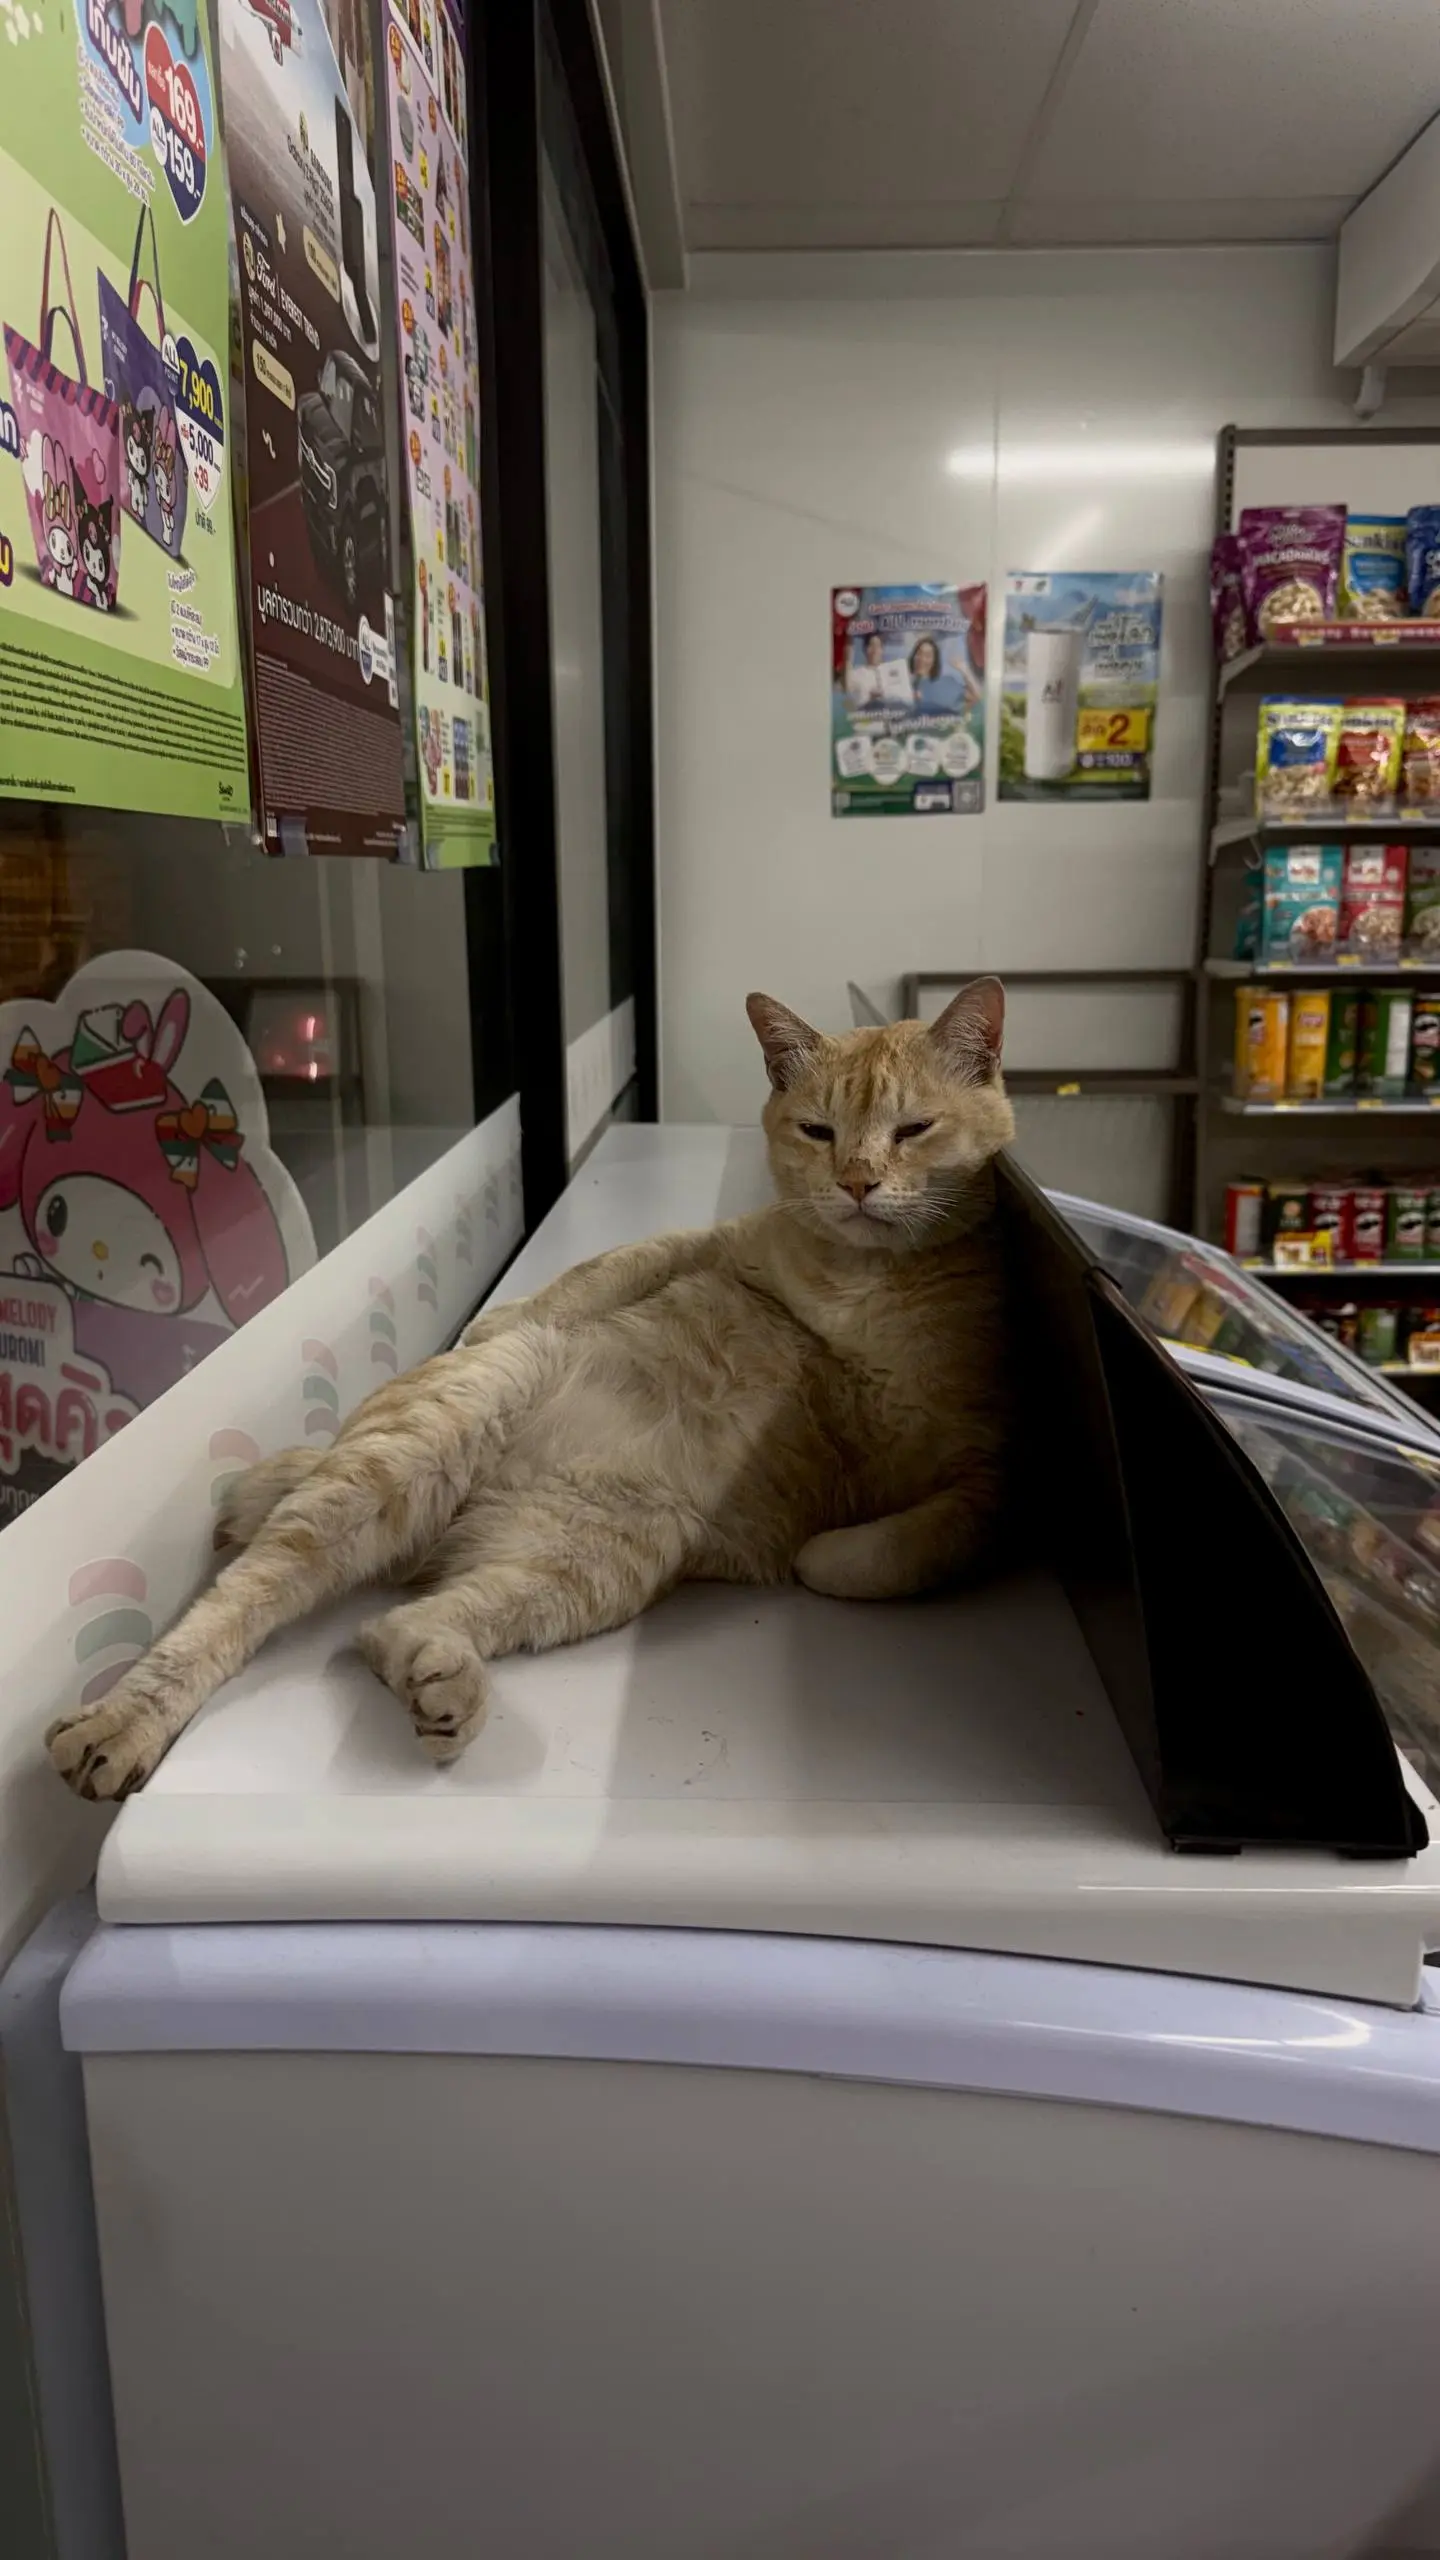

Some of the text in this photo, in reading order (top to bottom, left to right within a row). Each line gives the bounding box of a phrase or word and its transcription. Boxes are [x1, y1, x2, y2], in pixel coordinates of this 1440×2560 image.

[257, 251, 276, 299] Ford
[281, 287, 303, 331] EVEREST
[165, 343, 178, 371] ALL
[180, 358, 214, 420] 7,900
[189, 423, 214, 466] 5,000
[257, 581, 313, 637] มูลค่ารวมกว่า
[314, 612, 346, 655] 2,875,900
[1109, 713, 1131, 747] 2
